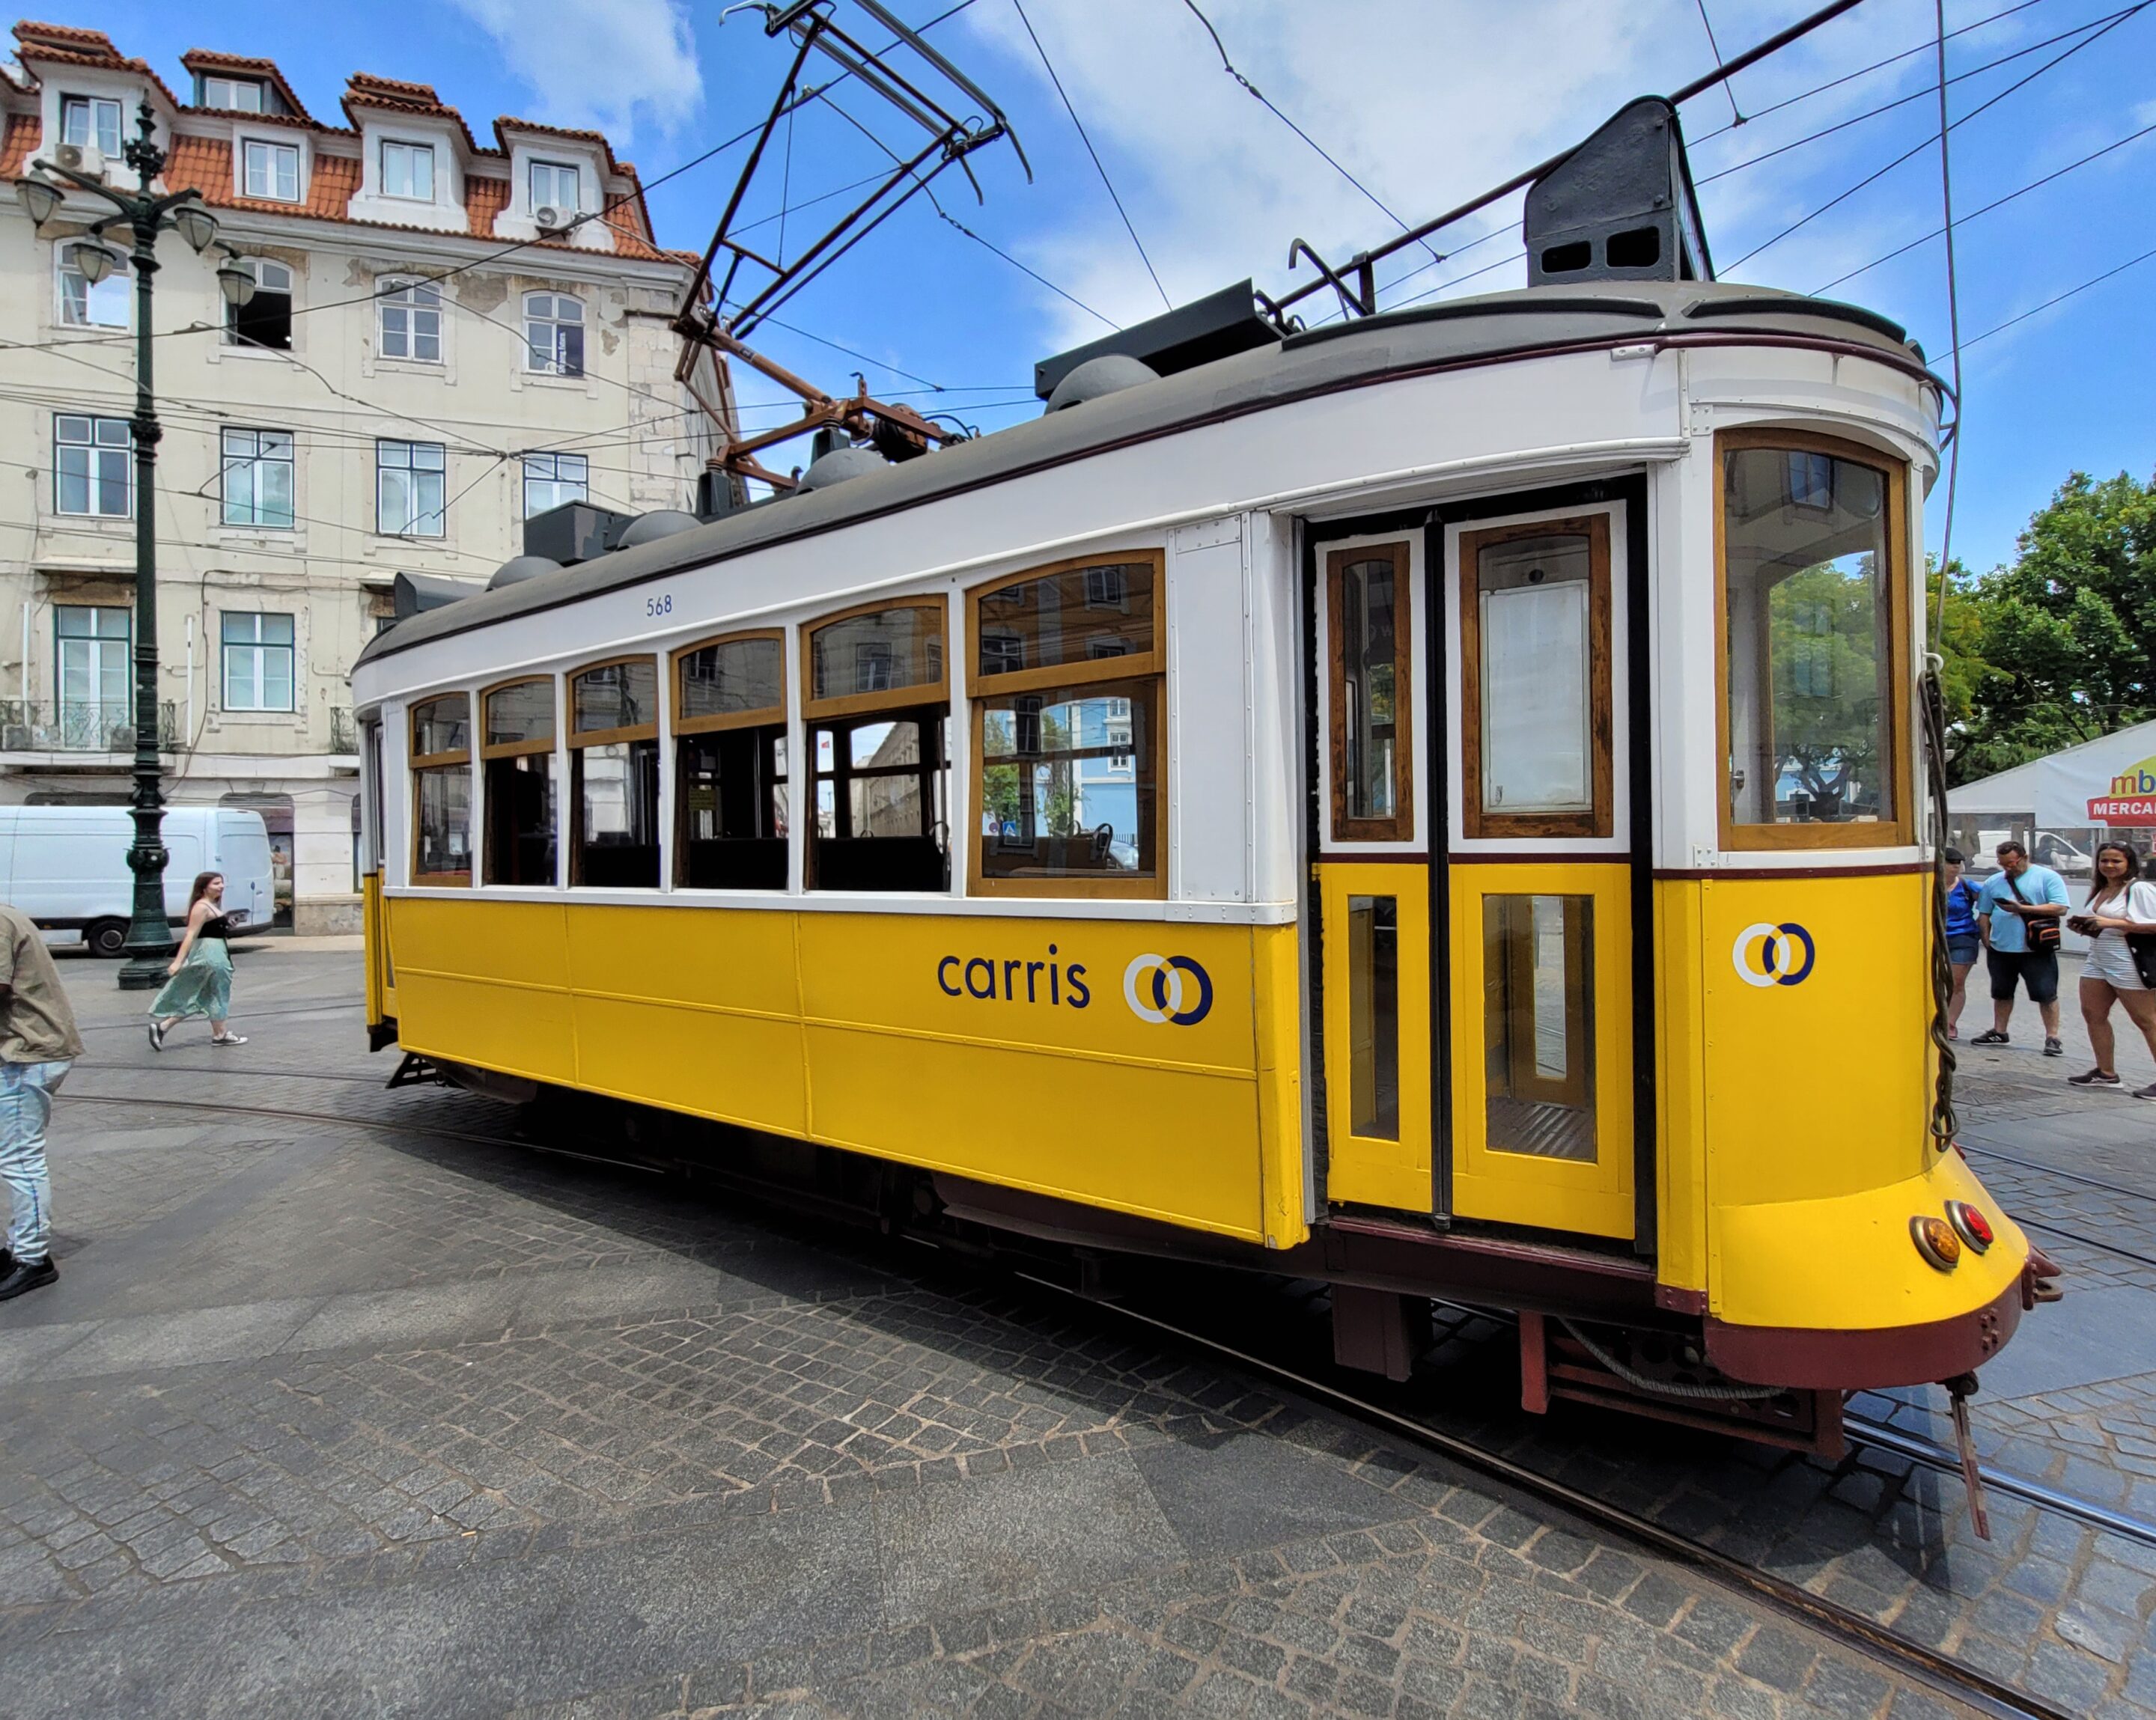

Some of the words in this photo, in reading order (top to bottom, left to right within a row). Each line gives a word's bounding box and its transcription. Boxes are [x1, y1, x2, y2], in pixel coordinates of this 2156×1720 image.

[646, 594, 672, 617] 568
[2093, 802, 2156, 815] MERCA
[937, 943, 1091, 1009] carris
